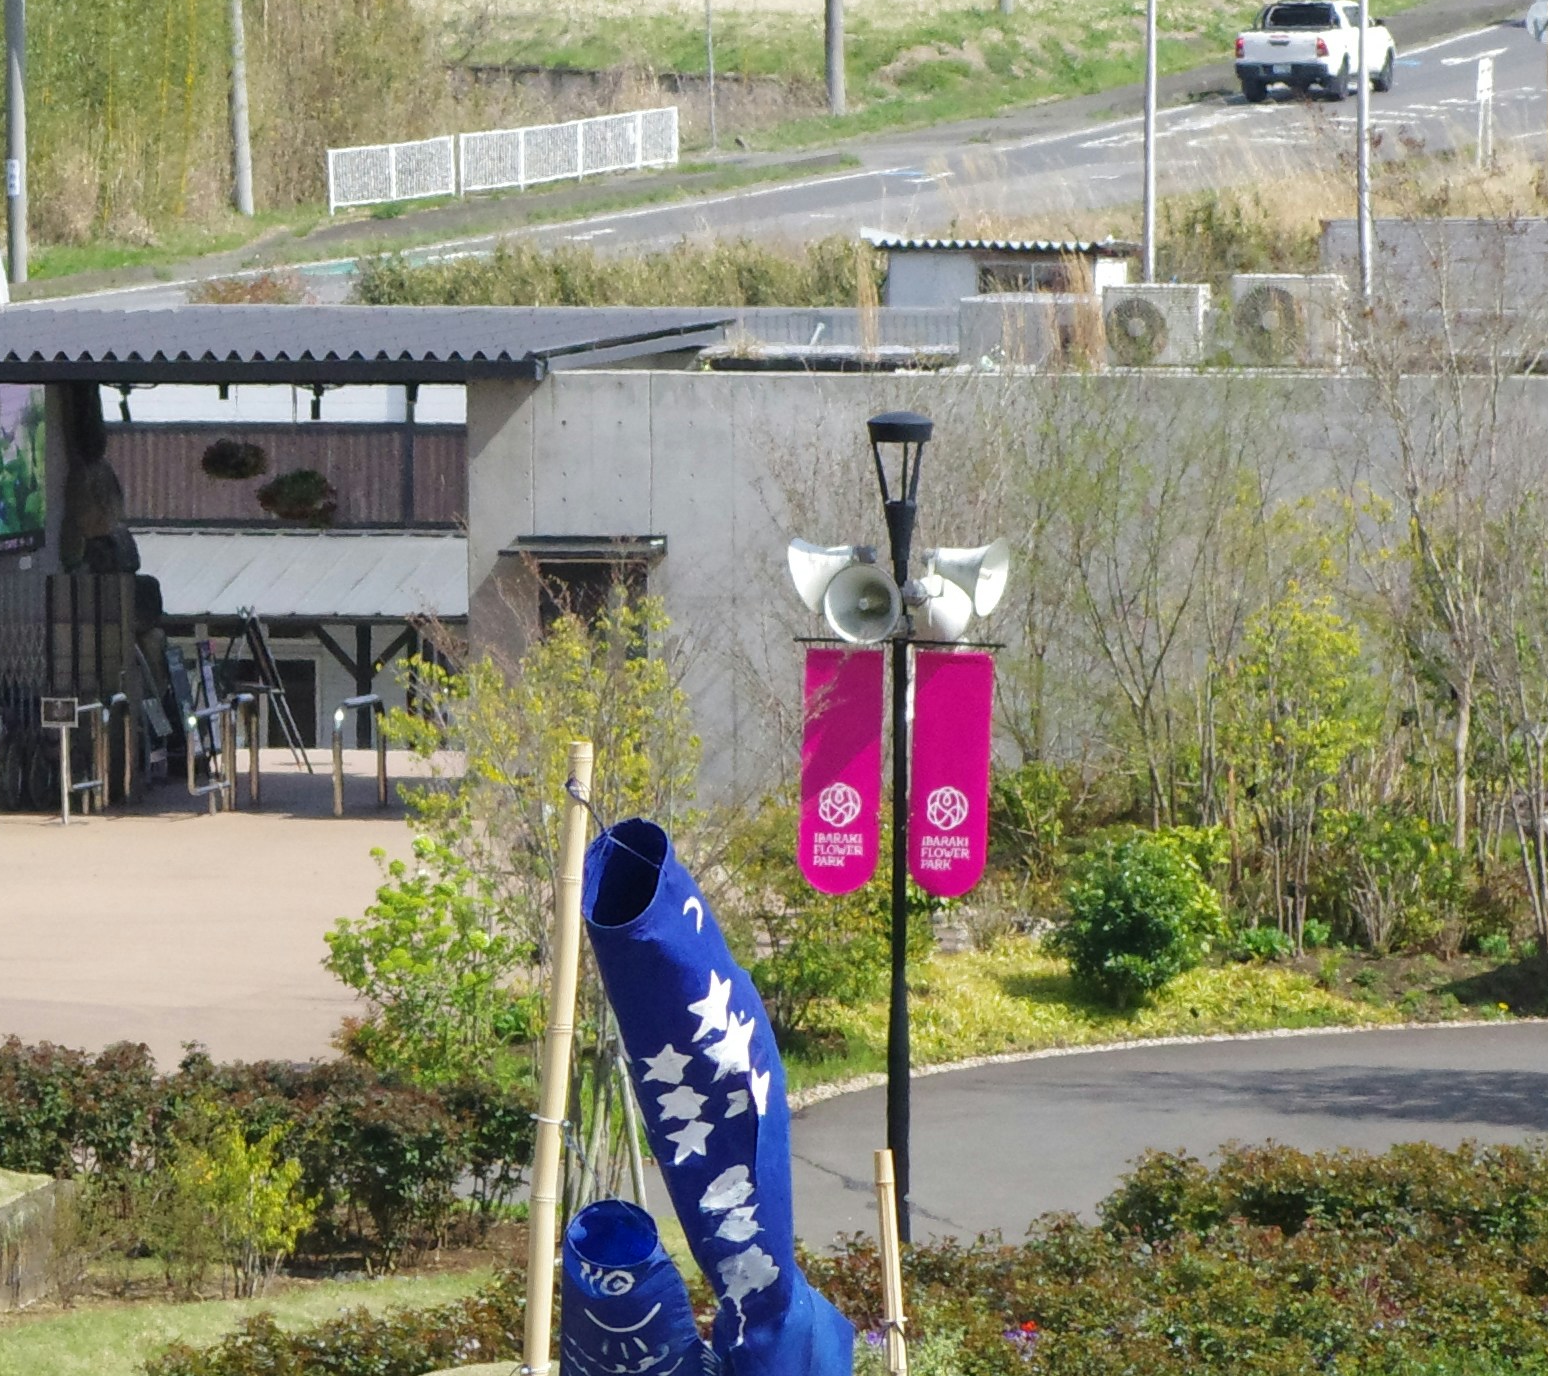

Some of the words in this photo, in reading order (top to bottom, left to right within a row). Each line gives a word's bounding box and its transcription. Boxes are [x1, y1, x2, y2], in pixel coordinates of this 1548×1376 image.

[813, 832, 863, 844] IBARAKI
[922, 835, 969, 846] IBARAKI
[813, 844, 864, 856] FLOWER
[920, 847, 970, 860] FLOWER
[813, 855, 845, 867] PARK
[920, 859, 952, 870] PARK
